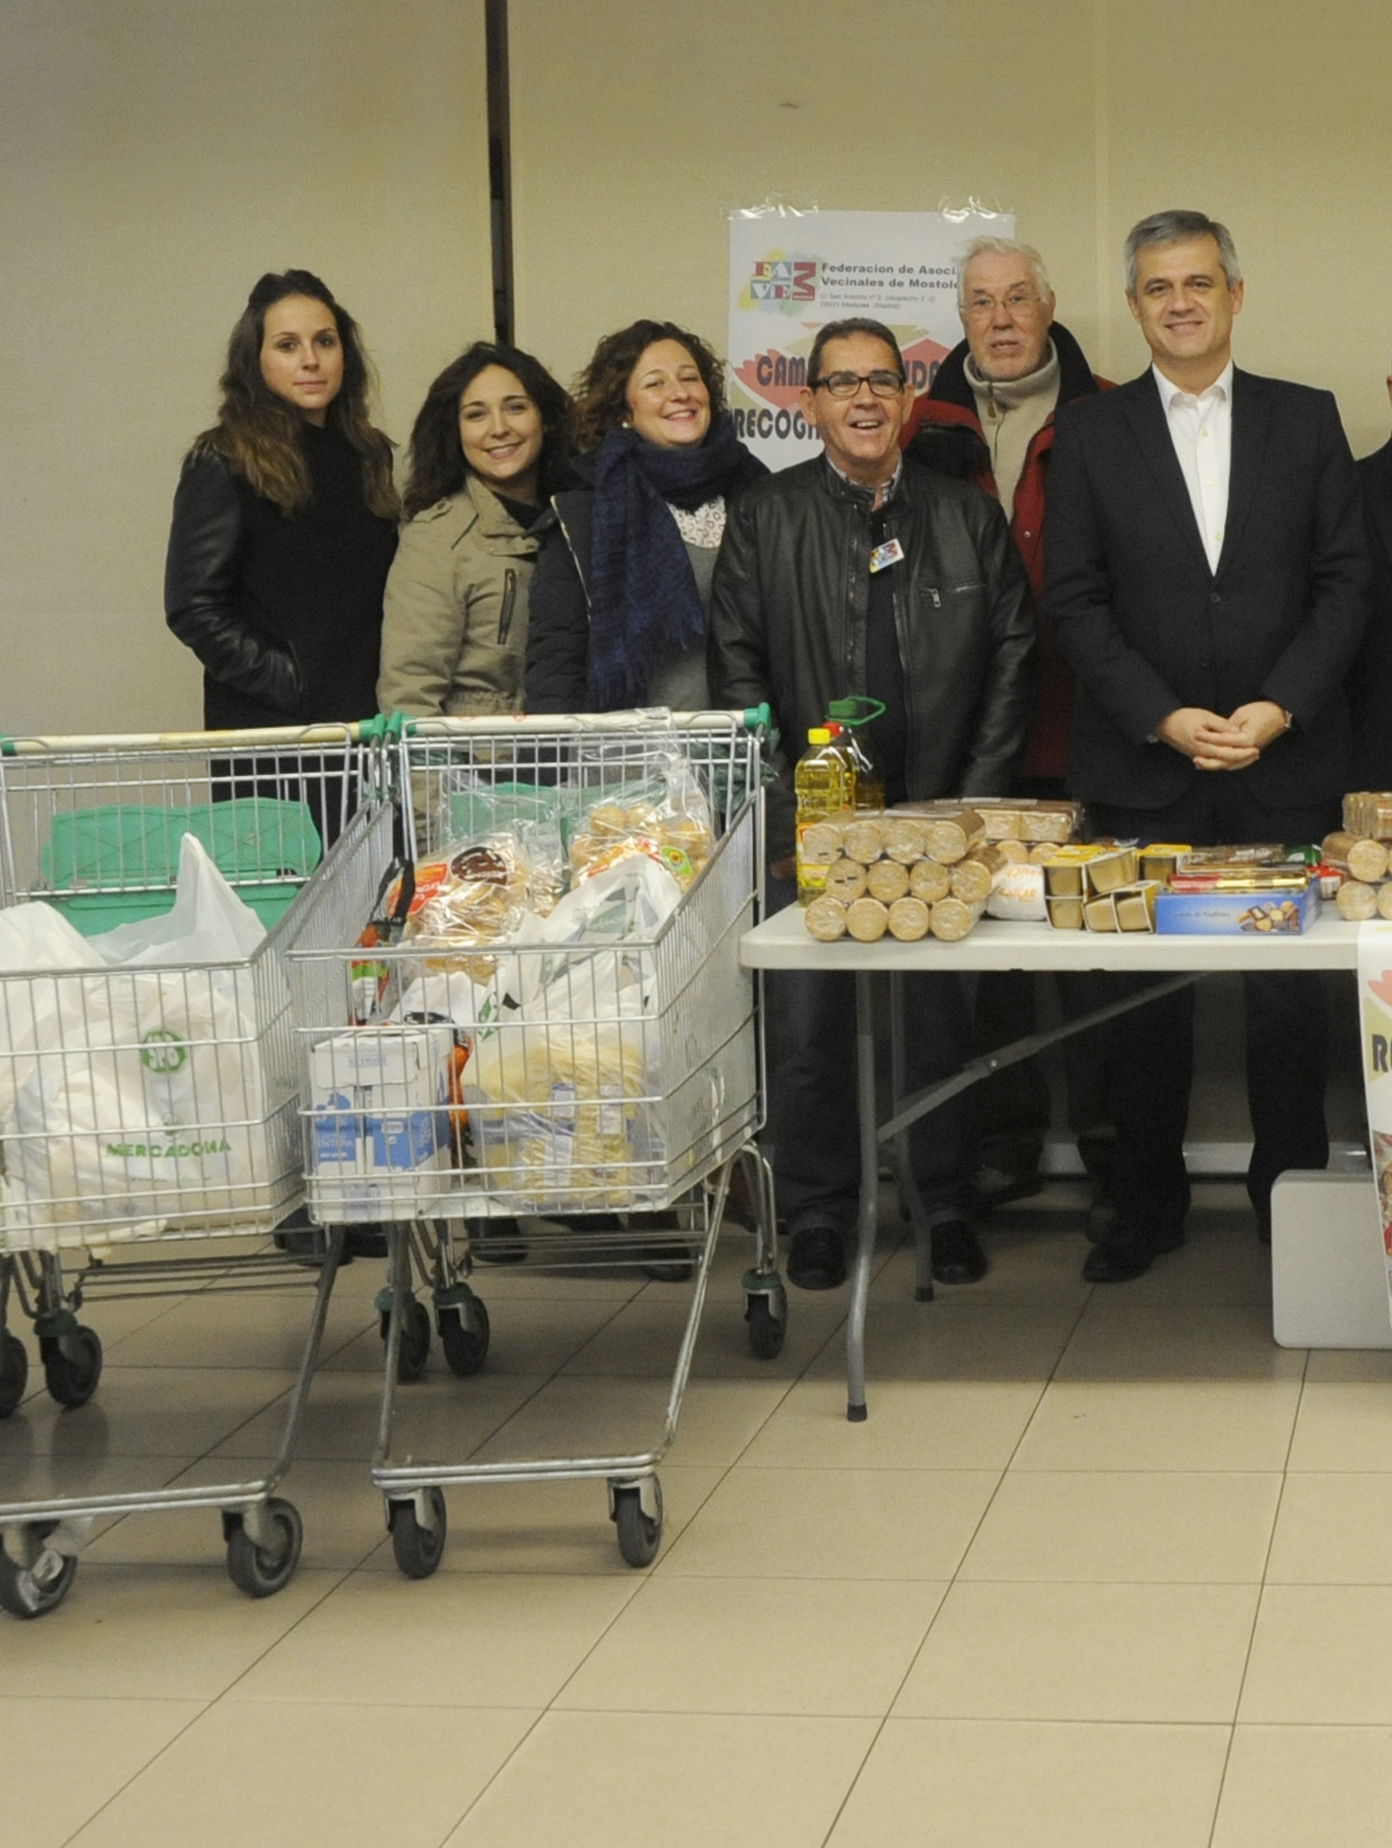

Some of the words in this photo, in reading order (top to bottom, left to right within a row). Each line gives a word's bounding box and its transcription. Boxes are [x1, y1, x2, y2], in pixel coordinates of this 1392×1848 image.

[821, 263, 895, 274] Federacion
[898, 264, 914, 275] de
[918, 265, 958, 275] Asoci
[821, 276, 889, 288] Vecinales
[889, 279, 904, 288] de
[756, 355, 809, 387] CAM
[106, 1138, 232, 1158] MERCADONA
